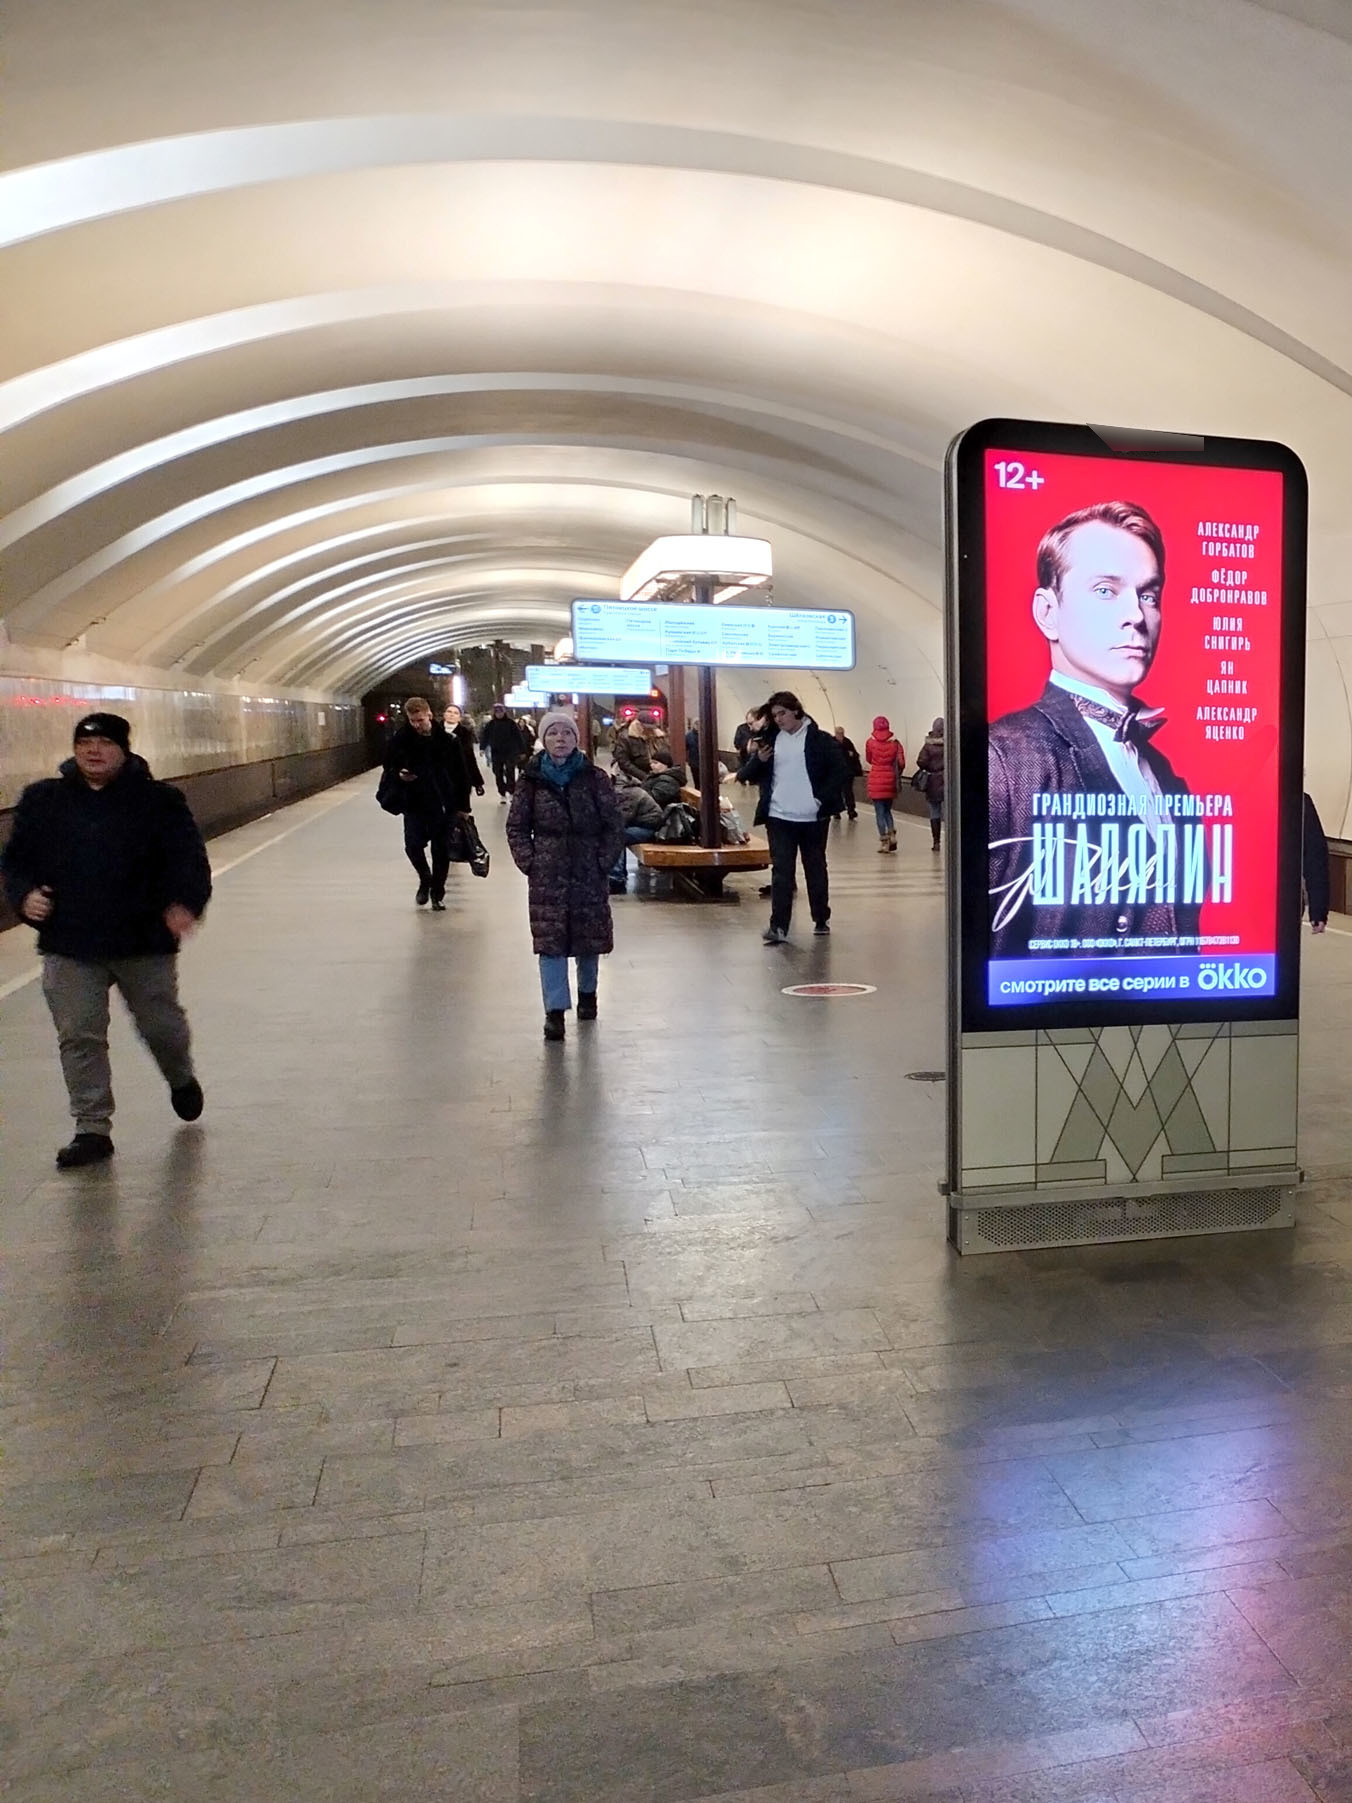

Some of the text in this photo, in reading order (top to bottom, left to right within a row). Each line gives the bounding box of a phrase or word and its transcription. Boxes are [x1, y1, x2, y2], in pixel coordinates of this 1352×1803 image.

[994, 461, 1045, 490] 12+
[1197, 521, 1260, 541] АЛЕКСАНДР
[1202, 541, 1255, 559] ГОРБАТОВ
[1190, 587, 1267, 606] ДОБРОНРАВОВ
[1213, 616, 1243, 631] ЮЛИЯ
[1204, 635, 1251, 651] СНИГИРЬ
[1220, 661, 1234, 675] ЯН
[1207, 679, 1248, 695] ЦАПНИК
[1196, 706, 1257, 723] АЛЕКСАНДР
[1205, 725, 1245, 741] ЯЦЕНКО
[1032, 793, 1233, 819] ГРАНДИОЗНАЯ ПРЕМЬЕРА
[1032, 823, 1233, 905] ШАЛЯПИН
[1000, 976, 1086, 995] смотрите
[1087, 976, 1121, 992] все
[1122, 974, 1176, 994] серии
[1179, 976, 1190, 988] в
